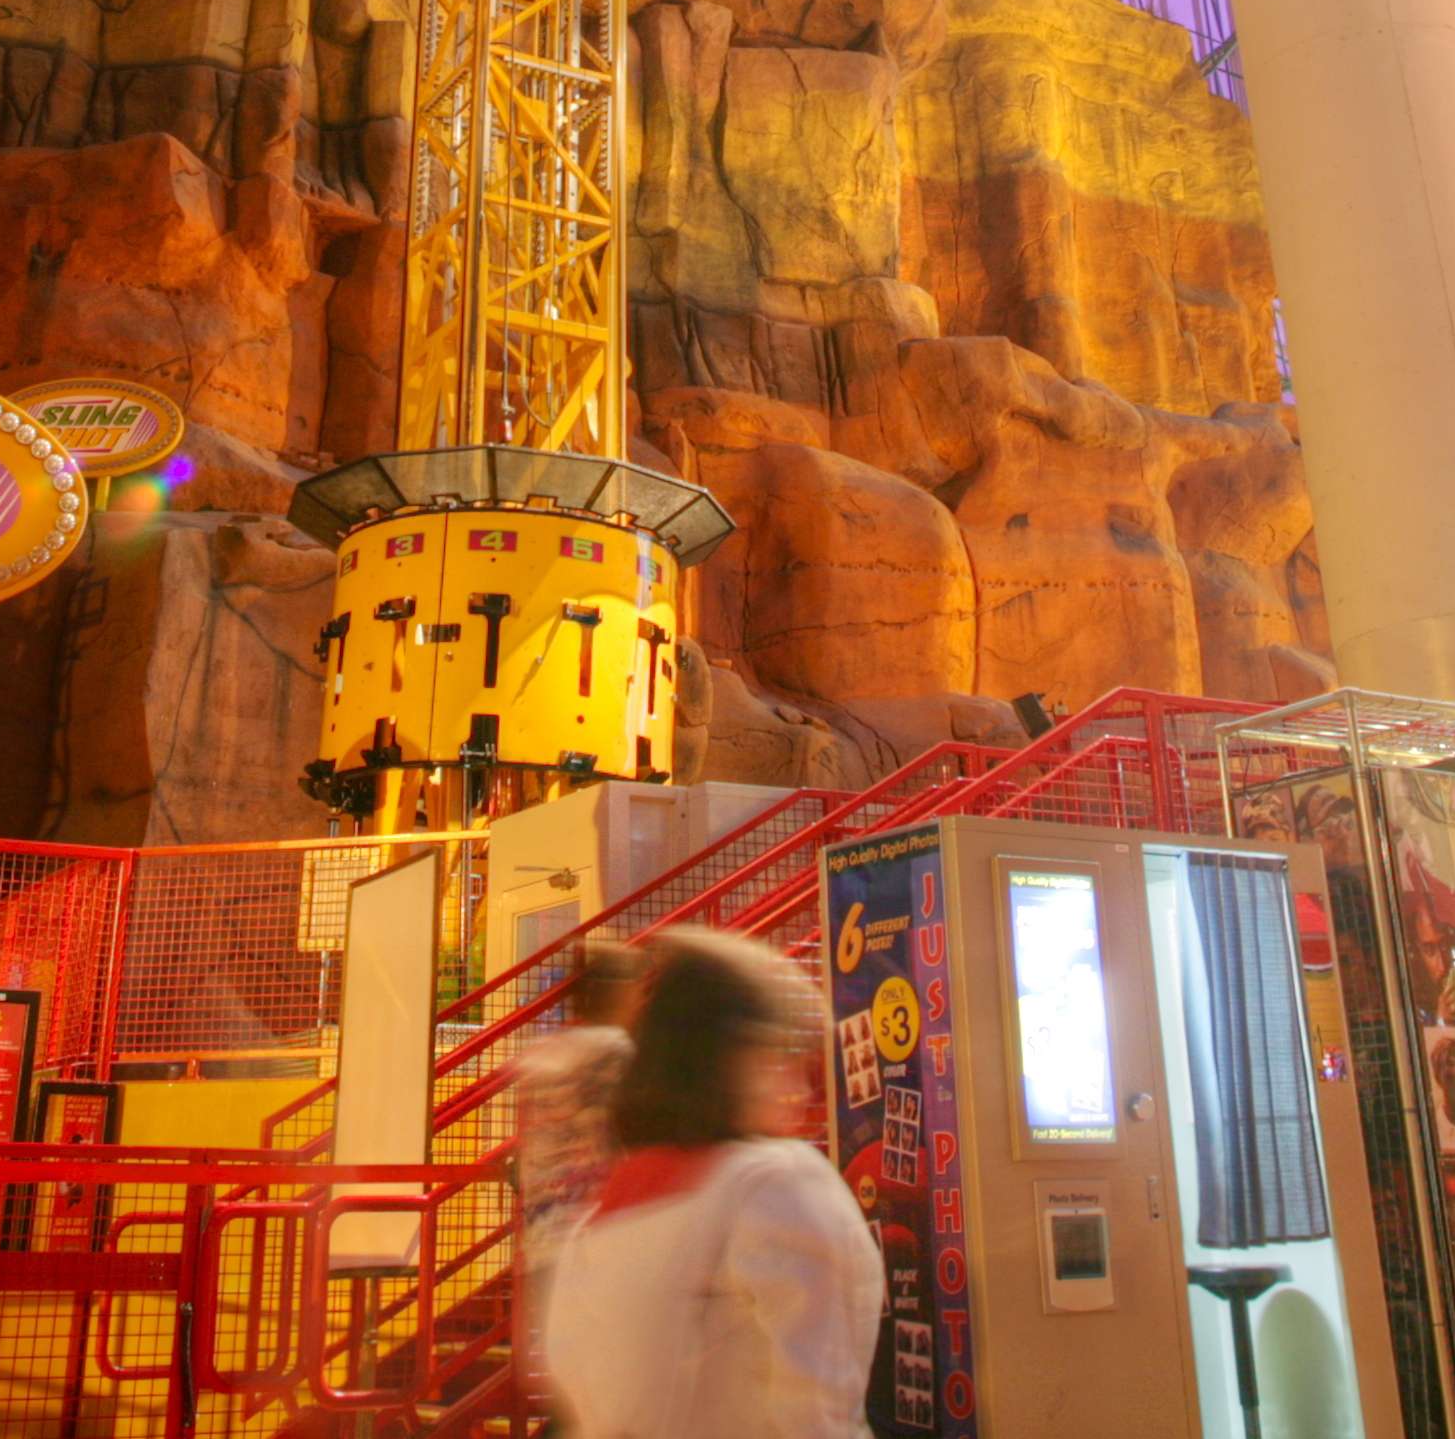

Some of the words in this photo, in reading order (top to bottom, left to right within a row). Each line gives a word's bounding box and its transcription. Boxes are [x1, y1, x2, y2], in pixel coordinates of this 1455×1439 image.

[40, 396, 143, 427] SLING
[395, 535, 415, 557] 3
[480, 531, 505, 551] 4
[572, 538, 594, 560] 5
[828, 855, 848, 873] High
[849, 847, 878, 866] Quality
[880, 839, 908, 860] Digital
[837, 902, 865, 974] 6
[919, 872, 951, 1077] JUST
[881, 986, 906, 1003] ONLY
[880, 1006, 912, 1047] $3
[932, 1131, 976, 1439] PHOTO
